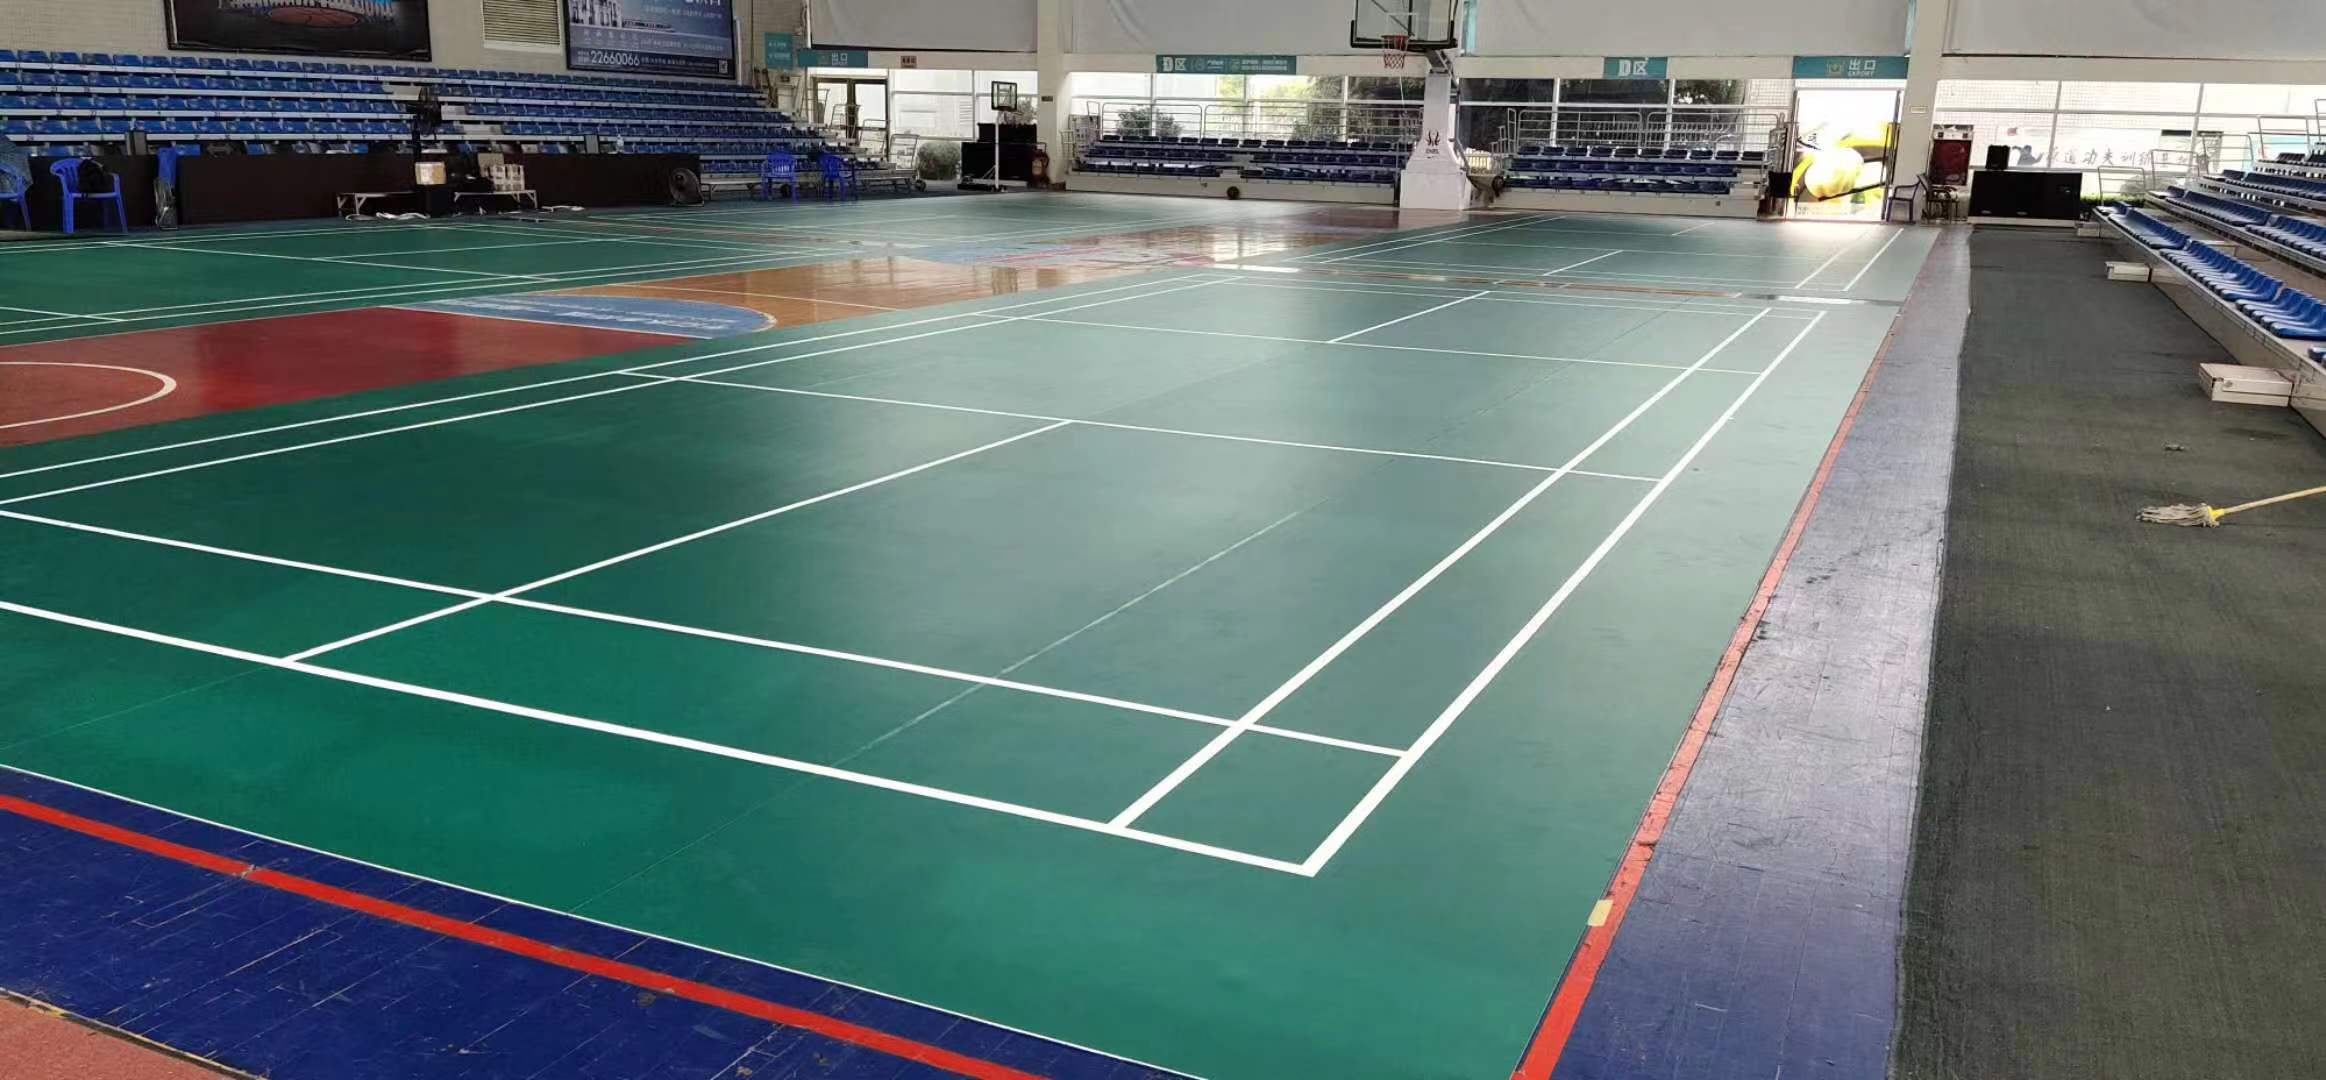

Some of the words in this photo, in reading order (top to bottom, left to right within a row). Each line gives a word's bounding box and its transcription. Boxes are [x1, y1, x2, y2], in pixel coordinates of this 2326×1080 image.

[590, 50, 641, 67] 22660066
[1848, 59, 1876, 71] 出口
[1618, 59, 1649, 77] D区
